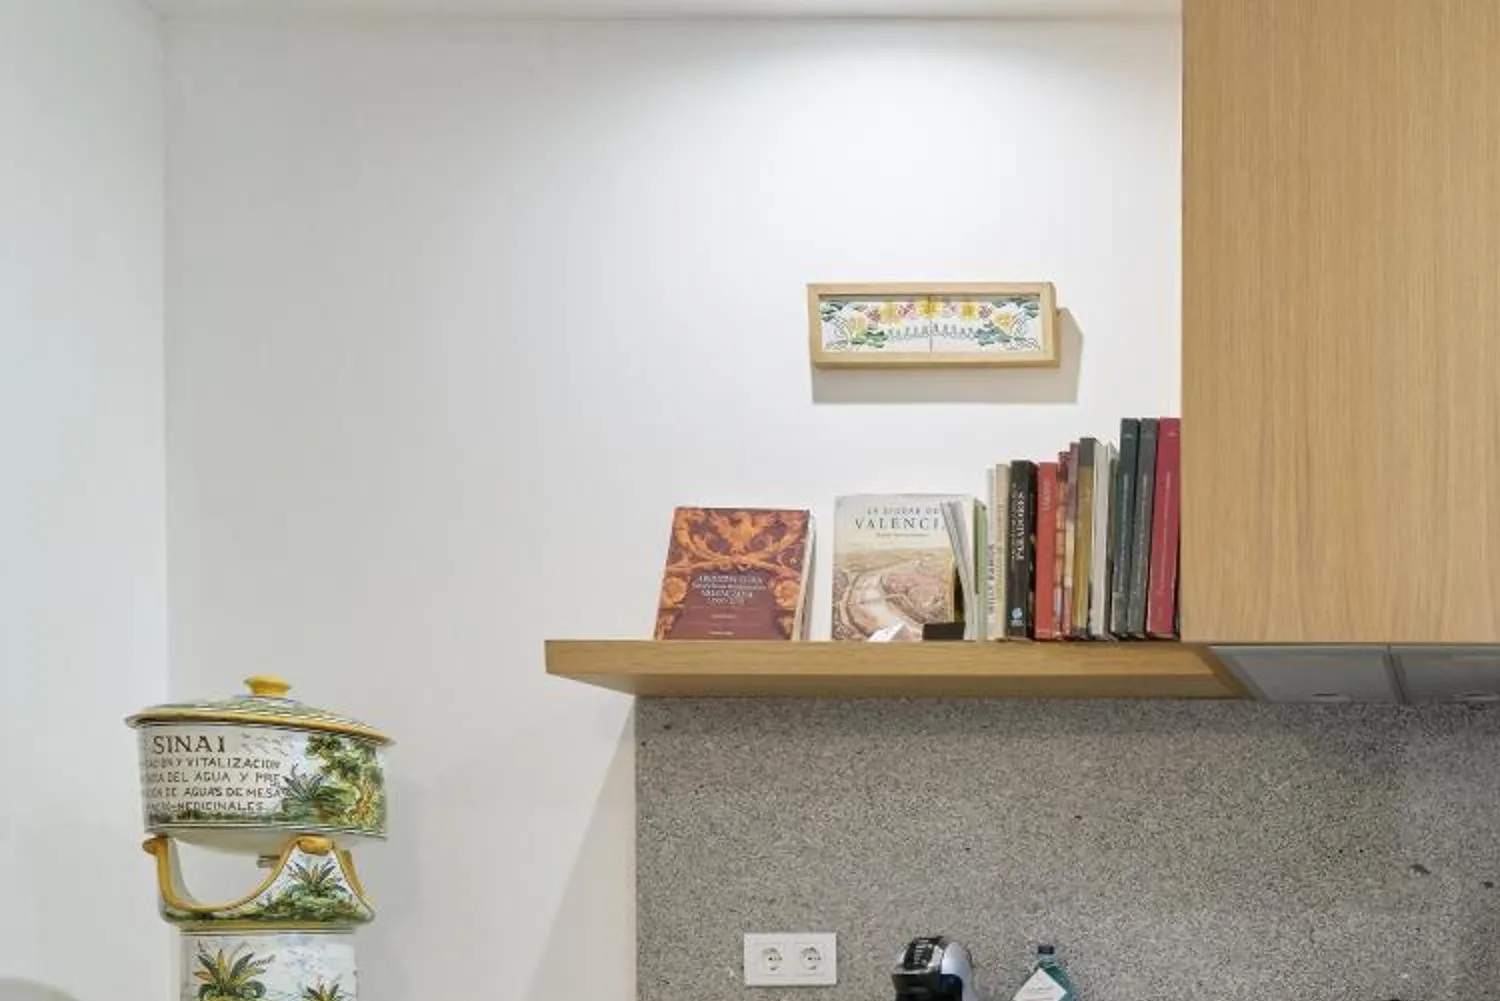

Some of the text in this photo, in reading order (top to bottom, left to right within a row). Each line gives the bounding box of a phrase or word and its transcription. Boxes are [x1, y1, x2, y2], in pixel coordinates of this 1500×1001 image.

[855, 517, 944, 529] VALENCI
[152, 735, 226, 754] SINAI
[193, 771, 230, 783] AGUA
[239, 771, 249, 783] Y
[183, 786, 223, 797] AGUAS
[226, 787, 243, 797] DE
